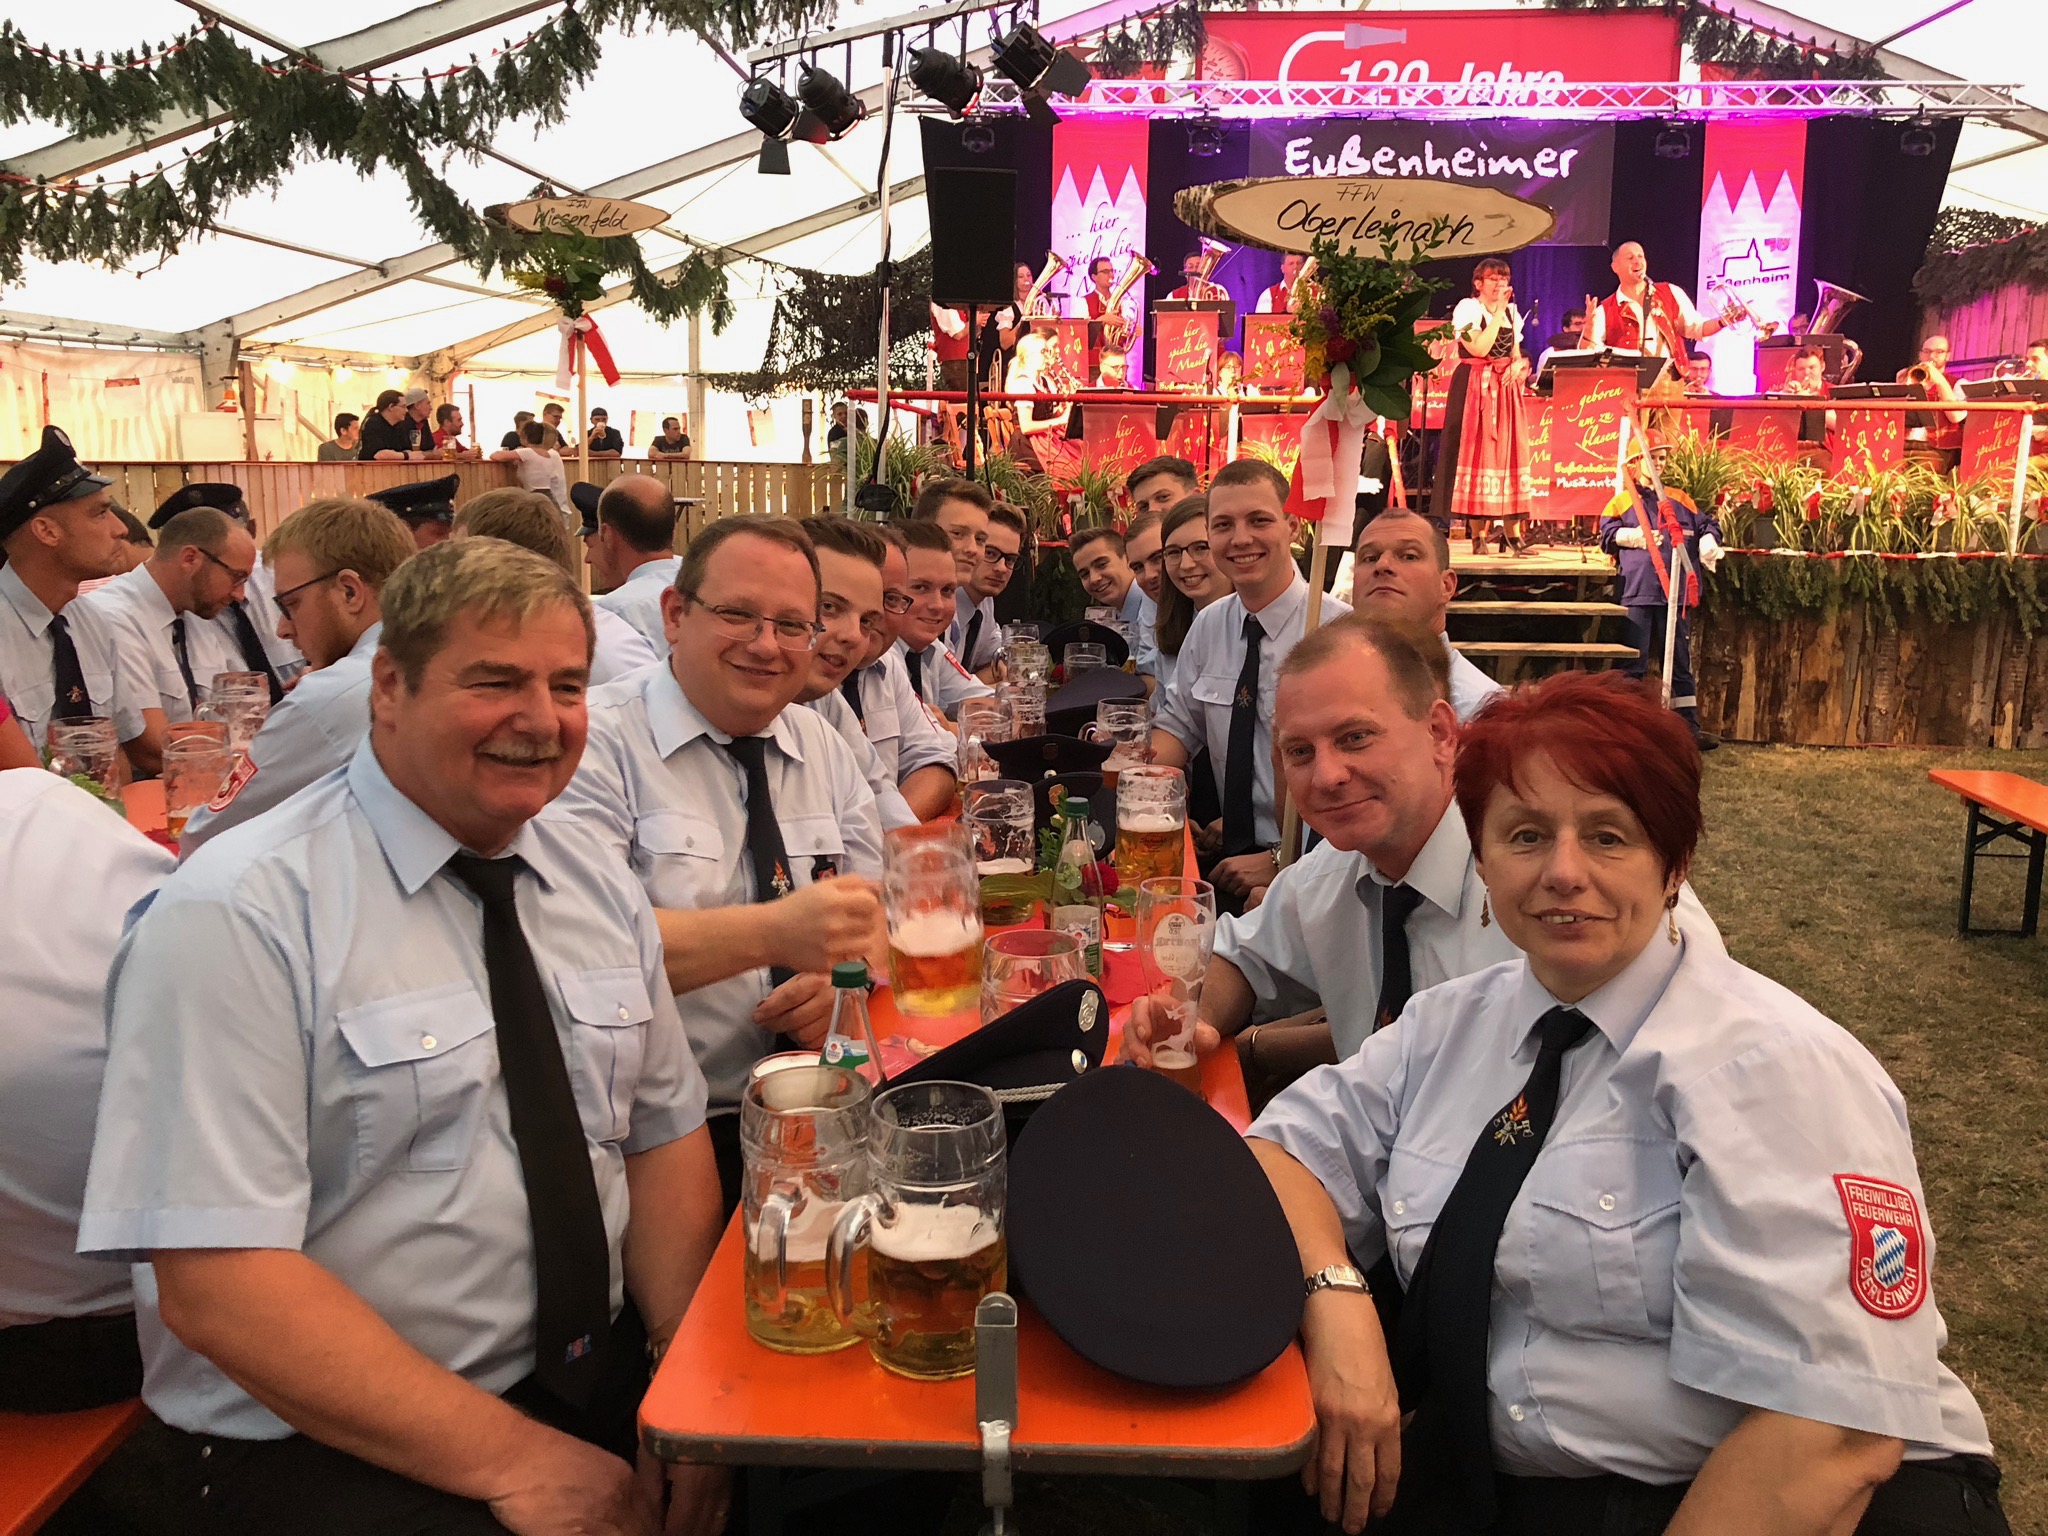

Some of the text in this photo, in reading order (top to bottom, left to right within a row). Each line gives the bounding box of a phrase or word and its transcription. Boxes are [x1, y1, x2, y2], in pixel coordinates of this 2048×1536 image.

[1339, 59, 1565, 105] 120 Jahre
[1284, 134, 1578, 178] Eußenheimer
[1337, 182, 1384, 202] FFW
[1089, 201, 1120, 233] hier
[1109, 227, 1132, 258] die
[1705, 273, 1790, 291] Eßenheim
[1183, 319, 1201, 338] hier
[1167, 332, 1209, 369] spielt die
[1567, 379, 1625, 423] geboren
[1114, 414, 1136, 440] hier
[1271, 422, 1290, 443] hier
[1577, 411, 1616, 428] um zu
[1755, 415, 1778, 437] hier
[1127, 433, 1146, 457] die
[1581, 424, 1619, 449] blasen
[1554, 461, 1618, 476] Eußenheim
[1848, 1185, 1911, 1212] FREIWILLIGE
[1852, 1201, 1914, 1228] FEUERWEHR
[1860, 1257, 1917, 1307] OBERLEINACH
